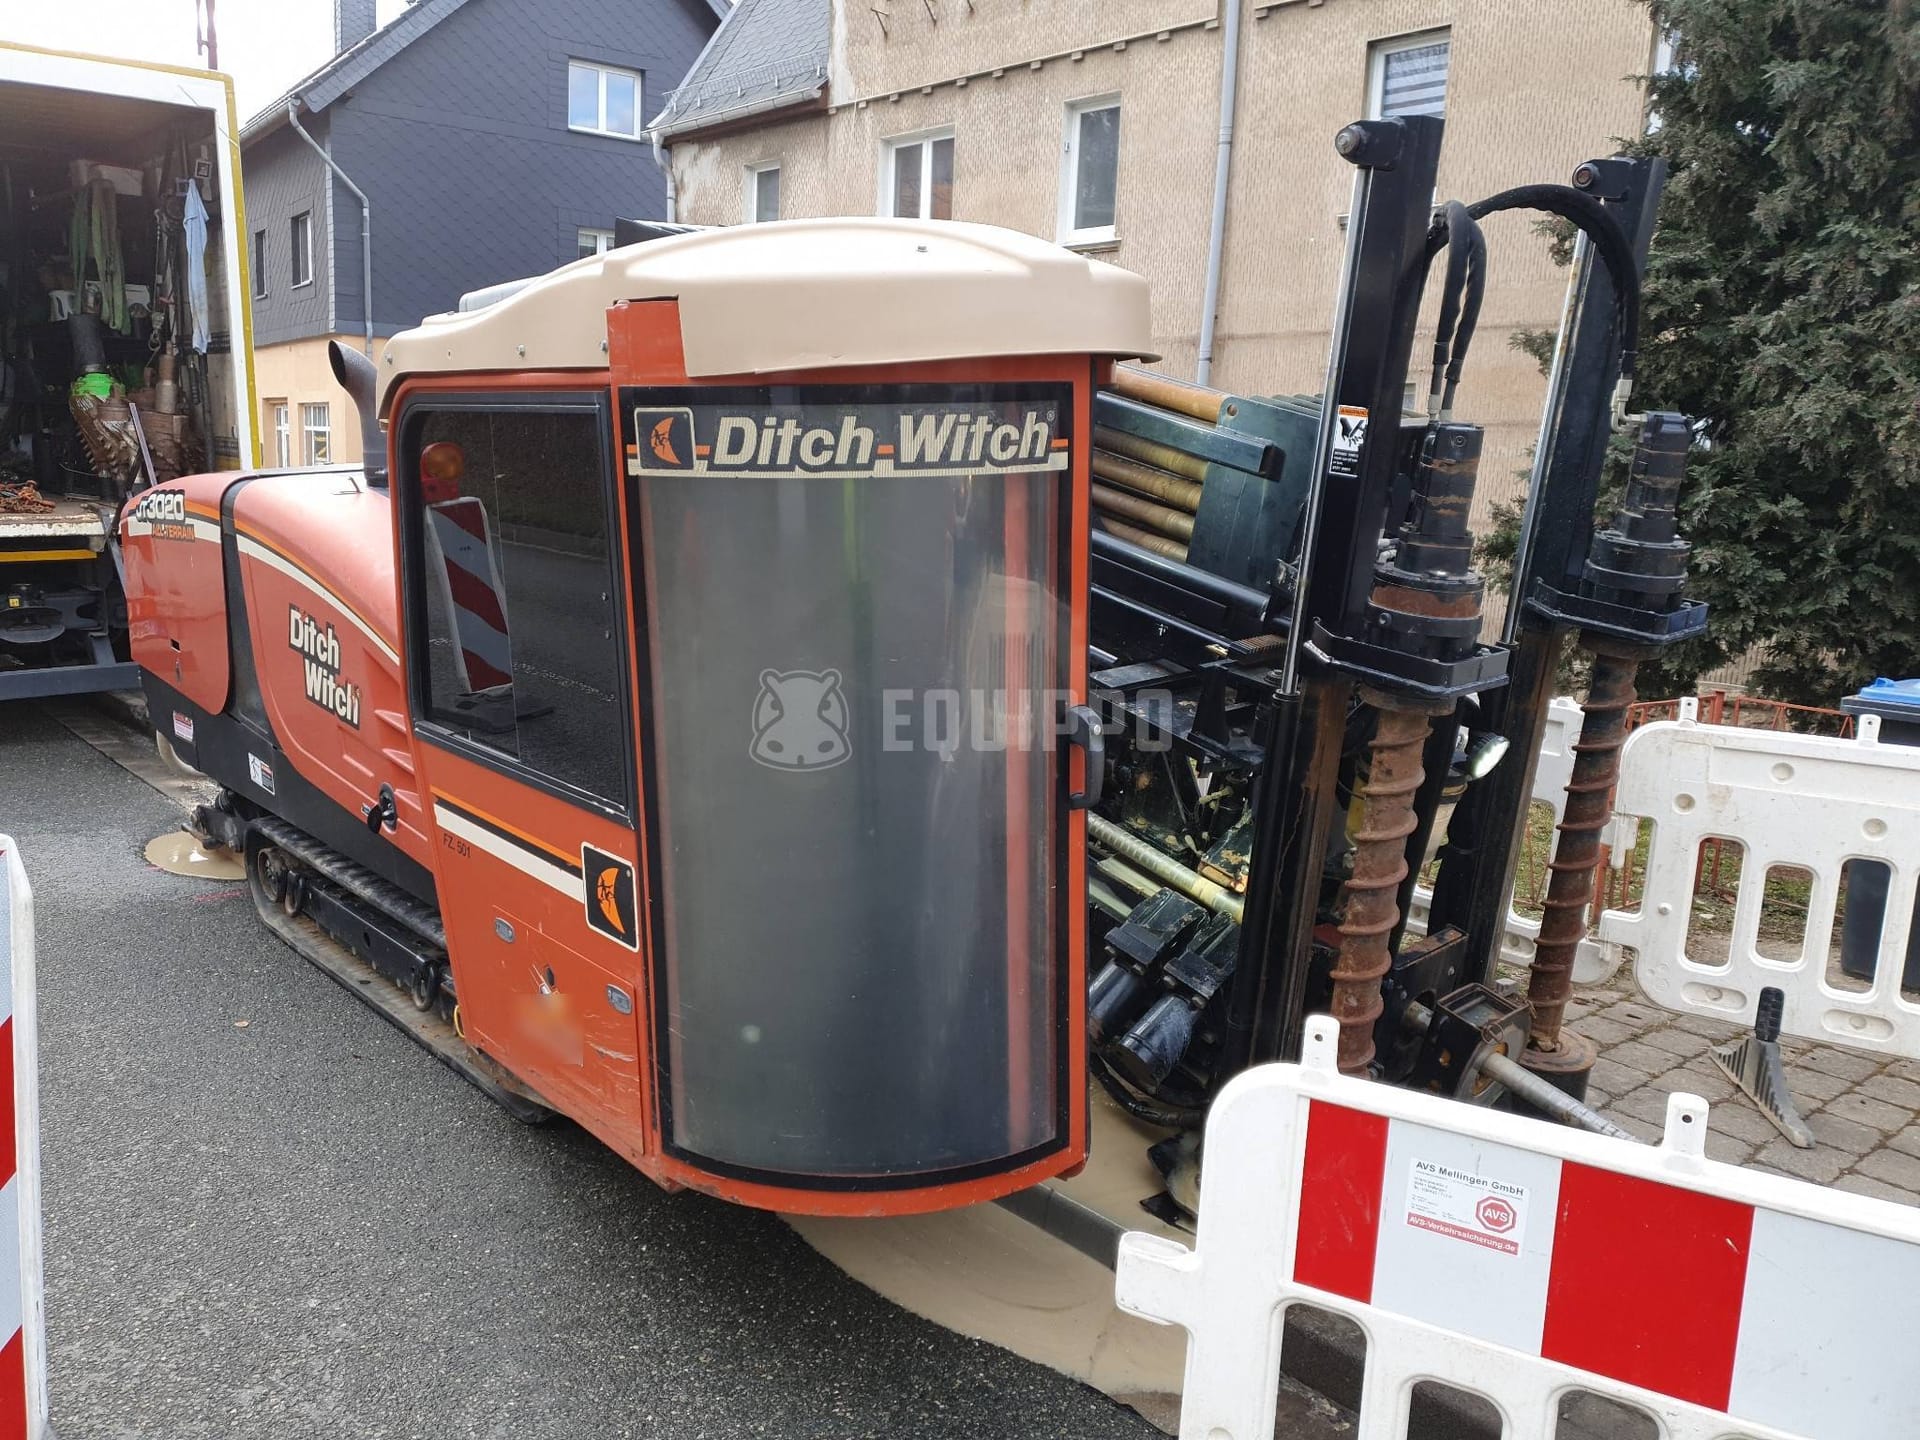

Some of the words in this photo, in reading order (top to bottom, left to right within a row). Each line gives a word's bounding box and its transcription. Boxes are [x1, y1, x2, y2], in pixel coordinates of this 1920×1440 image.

[713, 414, 875, 466] Ditch
[136, 493, 185, 521] JT3020
[290, 607, 340, 670] Ditch
[304, 658, 359, 726] Witch
[1416, 1161, 1436, 1174] AVS
[1438, 1167, 1489, 1186] Mellingen
[1491, 1181, 1524, 1197] GmbH
[1484, 1208, 1509, 1223] AVS
